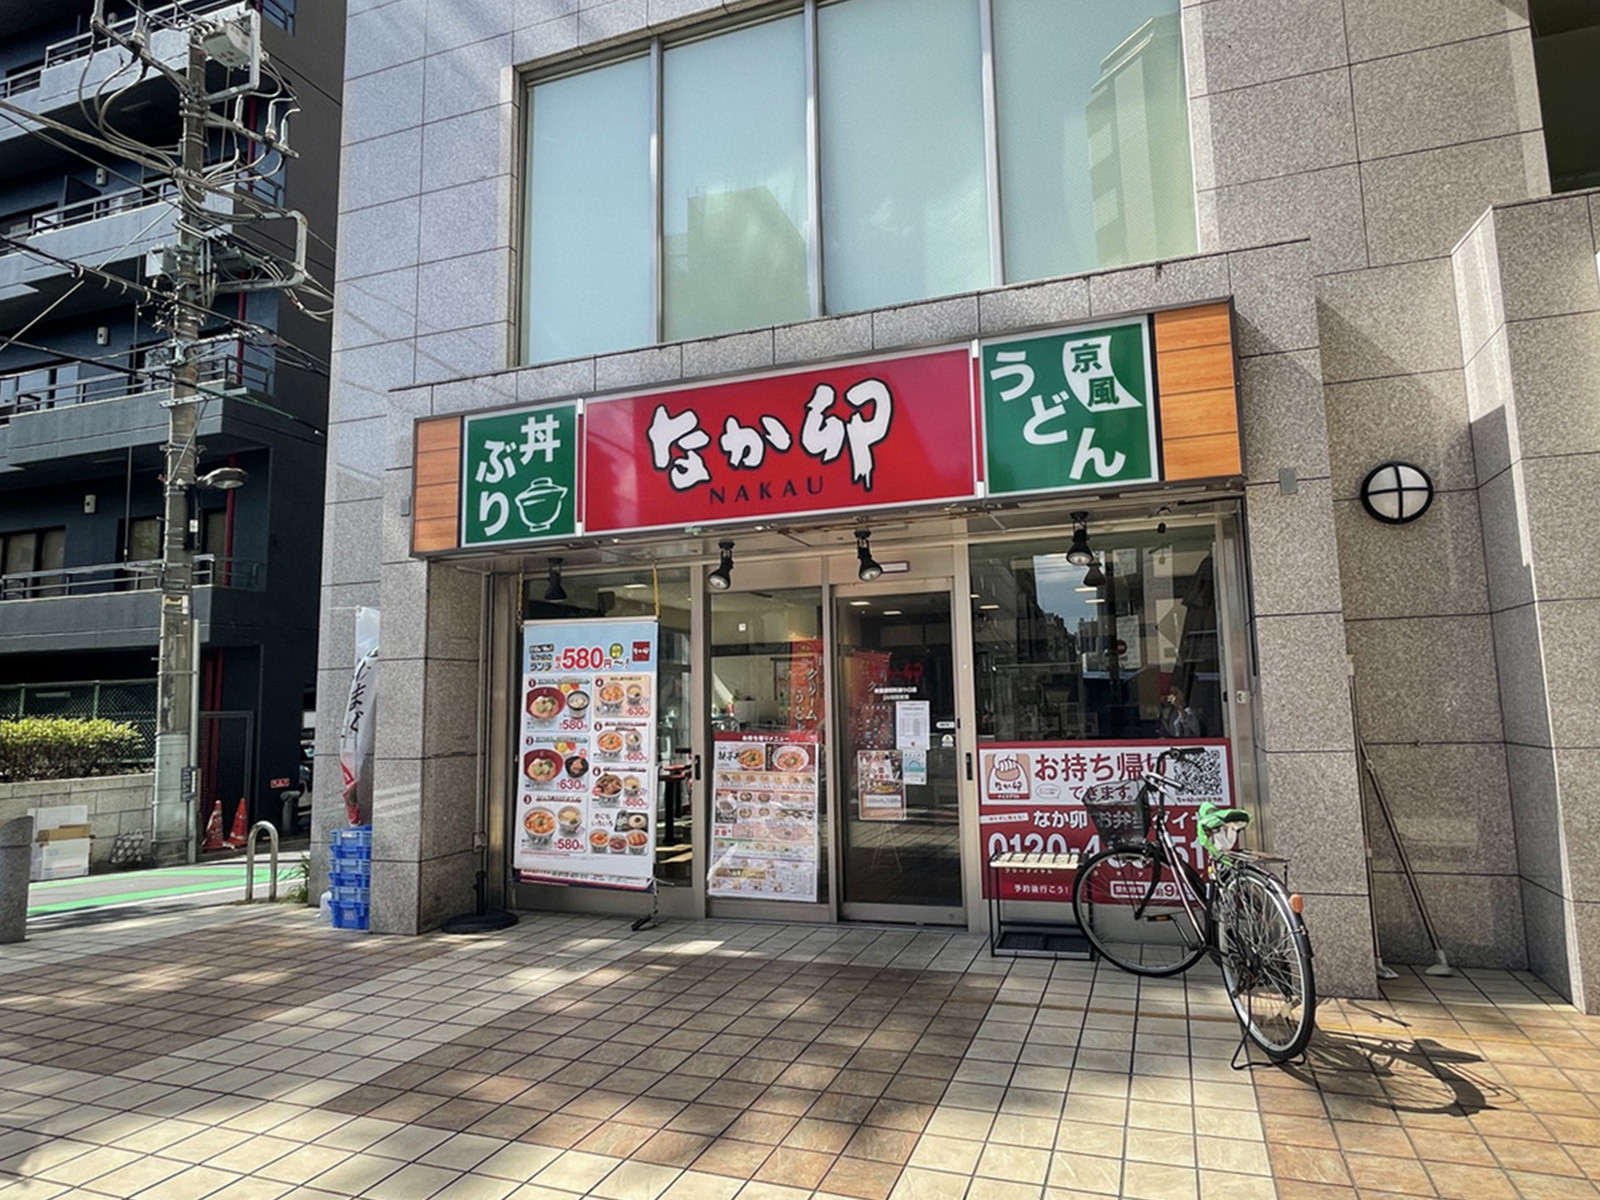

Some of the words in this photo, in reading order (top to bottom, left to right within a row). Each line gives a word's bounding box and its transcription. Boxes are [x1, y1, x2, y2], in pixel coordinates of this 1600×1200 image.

[1070, 343, 1120, 407] 京風
[647, 378, 894, 492] なか卯
[990, 351, 1127, 480] うどん
[709, 475, 824, 504] NAKAU
[1034, 753, 1167, 782] お持ち帰り
[1033, 810, 1088, 829] なか卯
